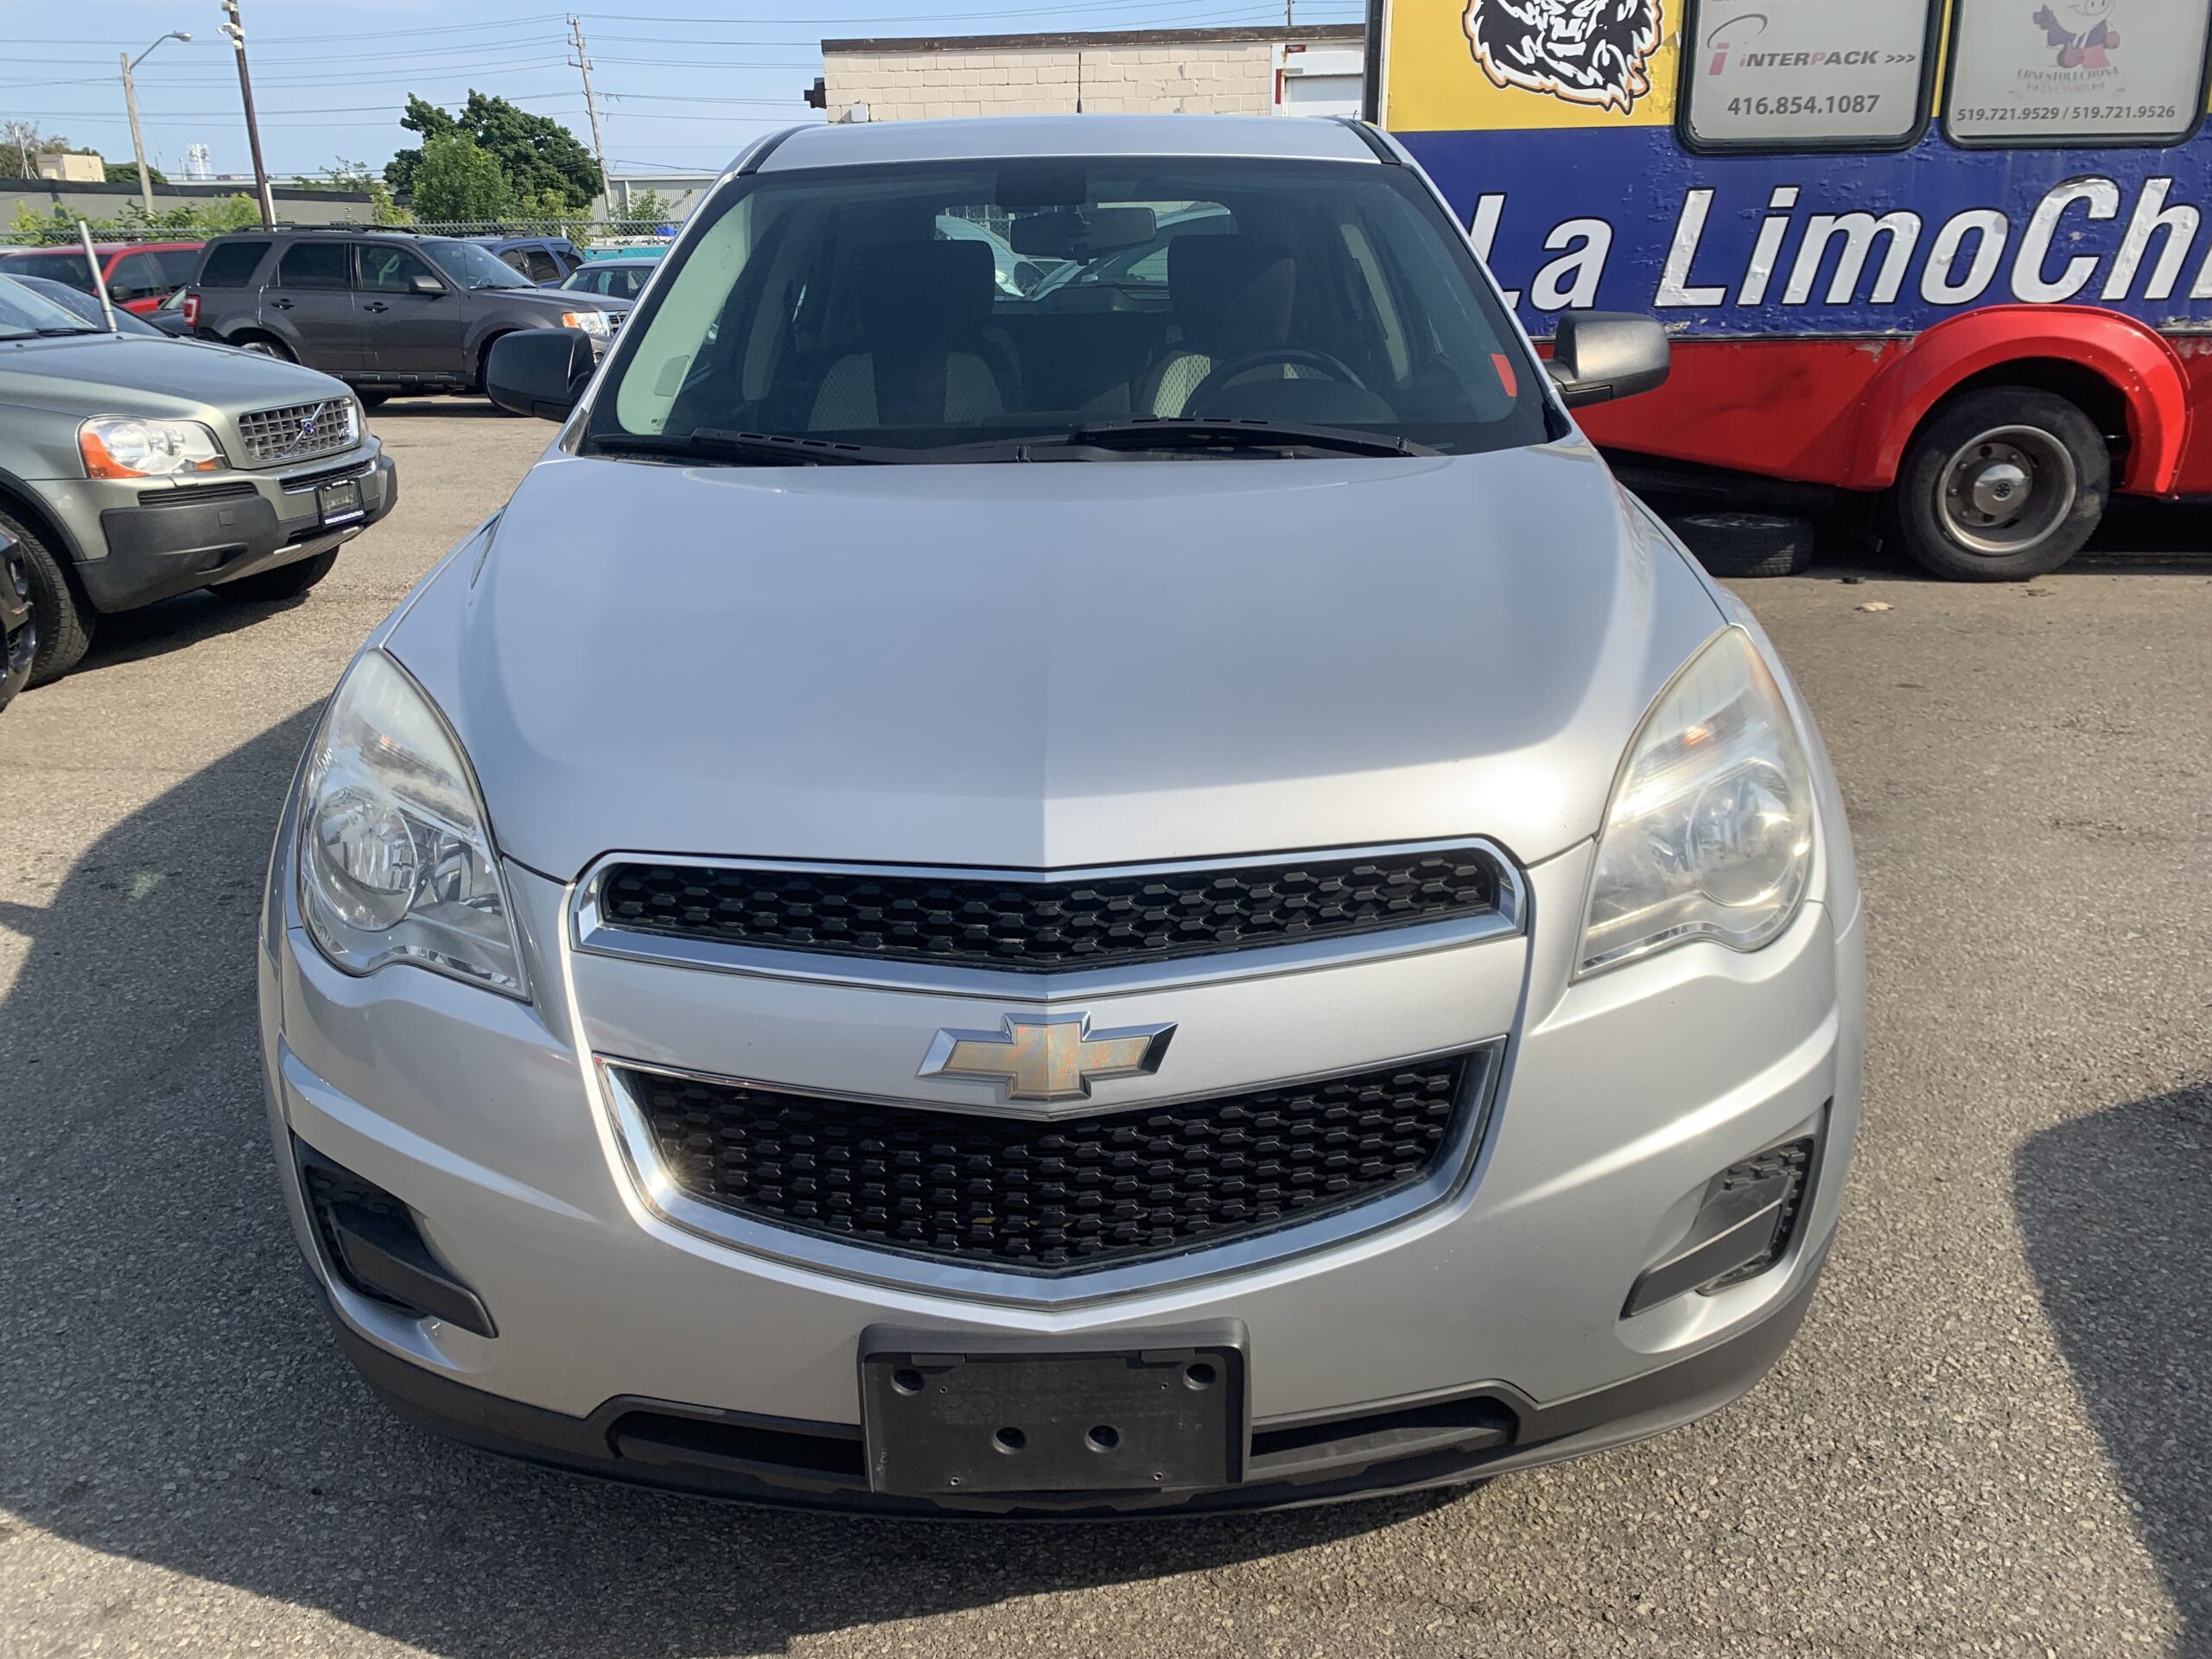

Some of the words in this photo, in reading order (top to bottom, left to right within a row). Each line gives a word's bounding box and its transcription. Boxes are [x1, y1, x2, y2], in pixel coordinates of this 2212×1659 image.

[1727, 94, 1880, 115] 416.854.1087
[1956, 107, 2060, 121] 519.721.9529
[2072, 105, 2176, 119] 519.721.9526
